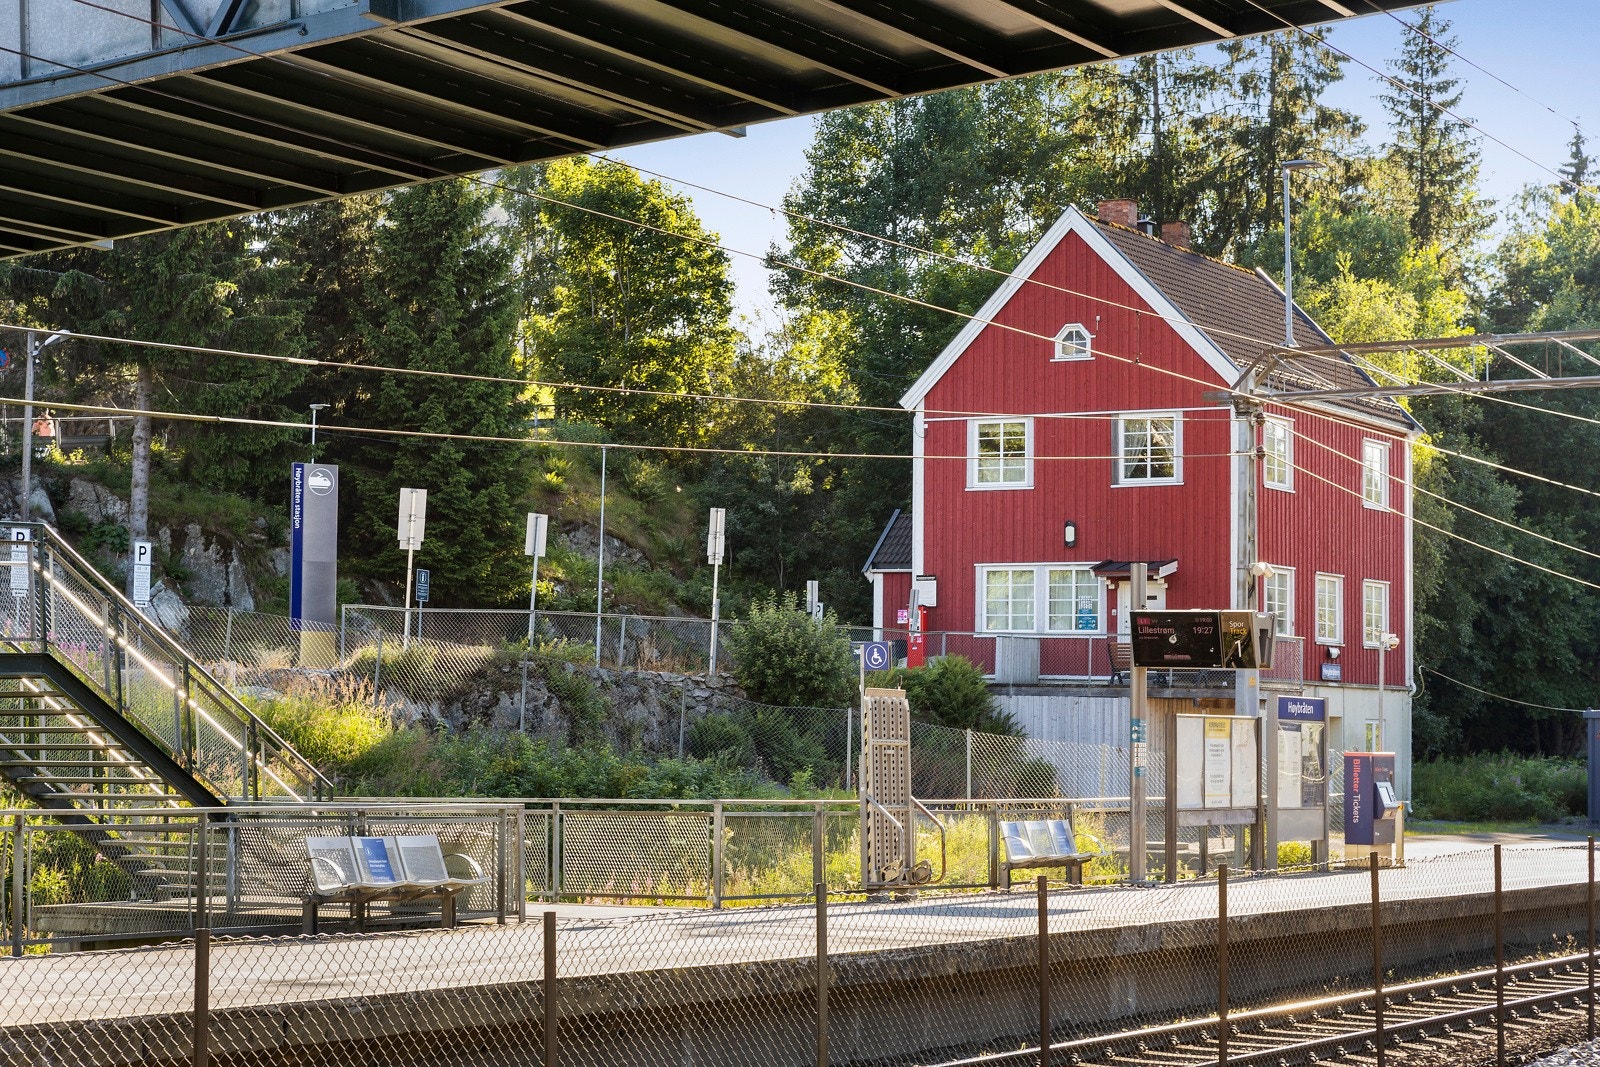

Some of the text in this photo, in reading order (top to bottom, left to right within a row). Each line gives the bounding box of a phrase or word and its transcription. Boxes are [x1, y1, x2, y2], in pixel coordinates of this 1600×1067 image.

[293, 467, 302, 529] Høybråten stasjon
[138, 545, 147, 561] P
[1137, 626, 1175, 634] Lillestrøm
[1192, 626, 1214, 634] 19:27
[1229, 620, 1245, 628] Spor
[1230, 627, 1247, 635] Track
[1235, 639, 1242, 658] 1
[1287, 701, 1314, 716] Høybråten
[1353, 759, 1361, 824] Billetter Tickets
